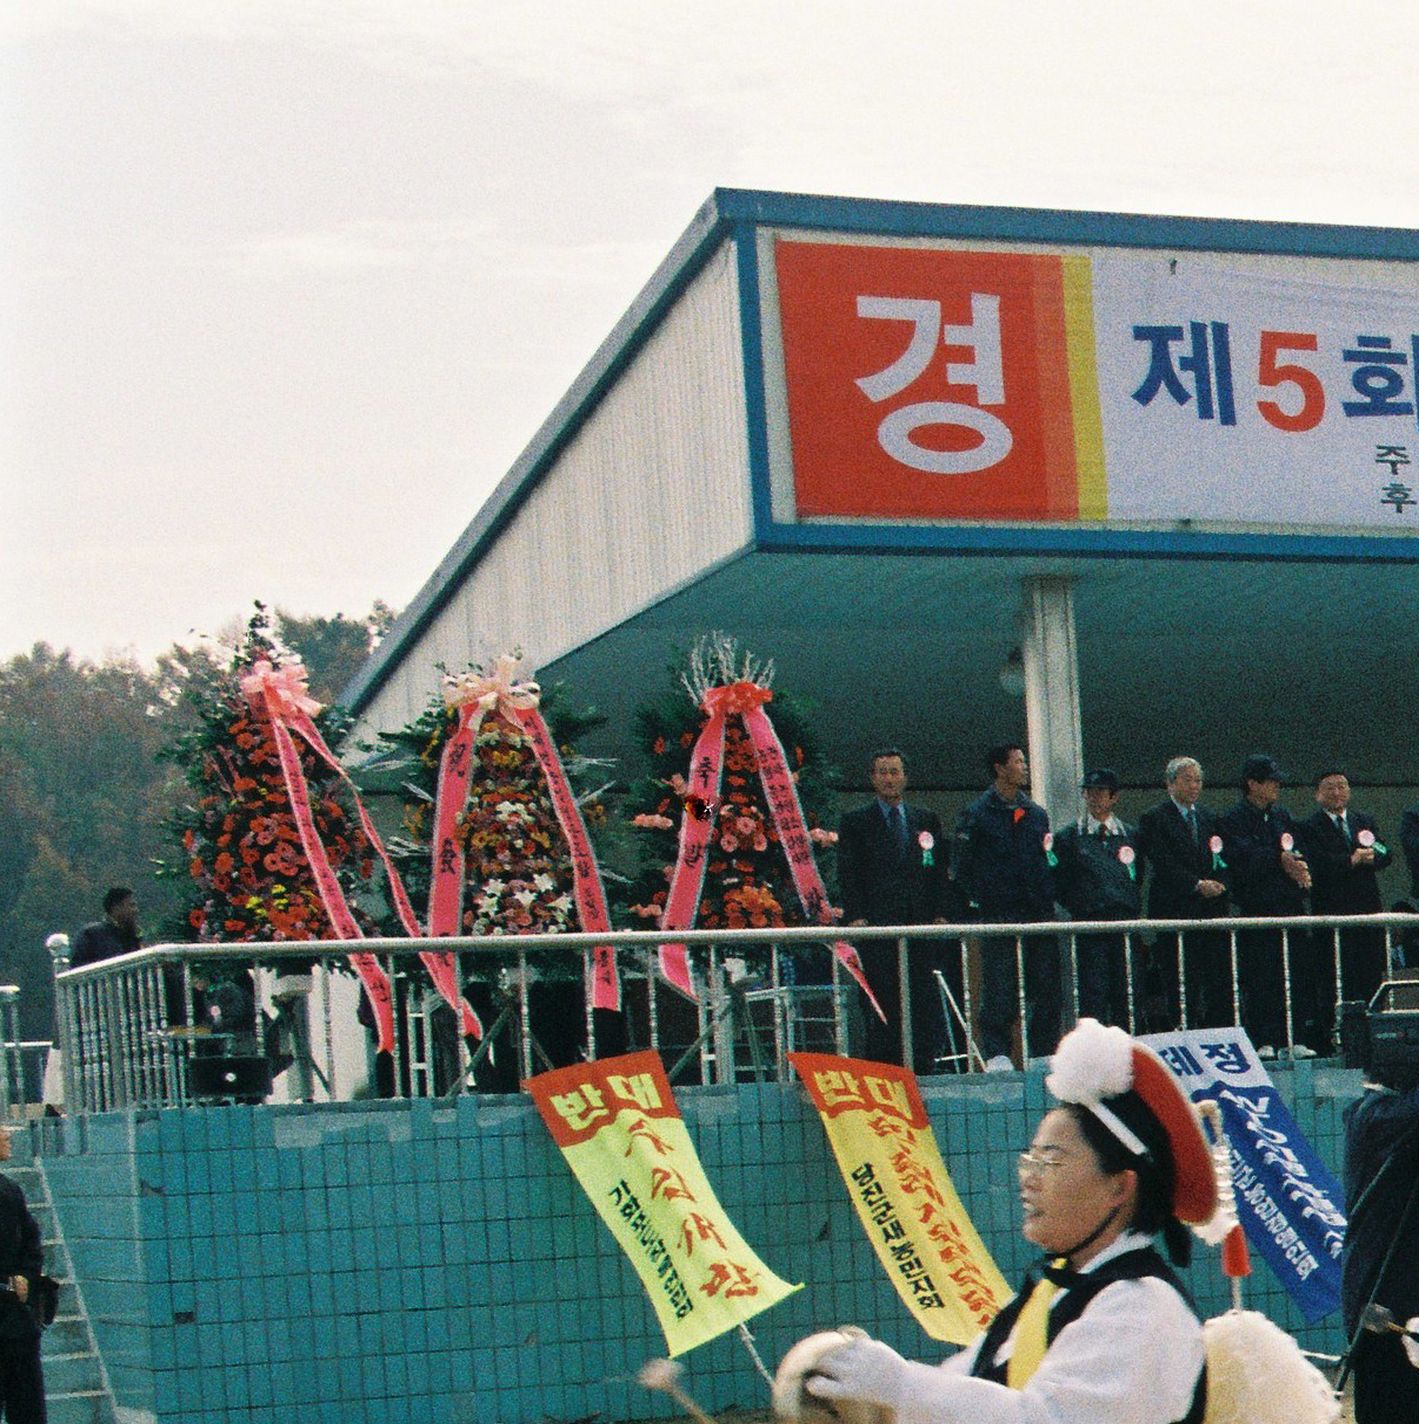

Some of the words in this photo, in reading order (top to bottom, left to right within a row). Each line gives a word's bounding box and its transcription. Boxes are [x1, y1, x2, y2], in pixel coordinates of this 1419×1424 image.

[855, 292, 1013, 475] 경
[550, 1073, 663, 1132] 반대
[813, 1070, 914, 1121] 반대
